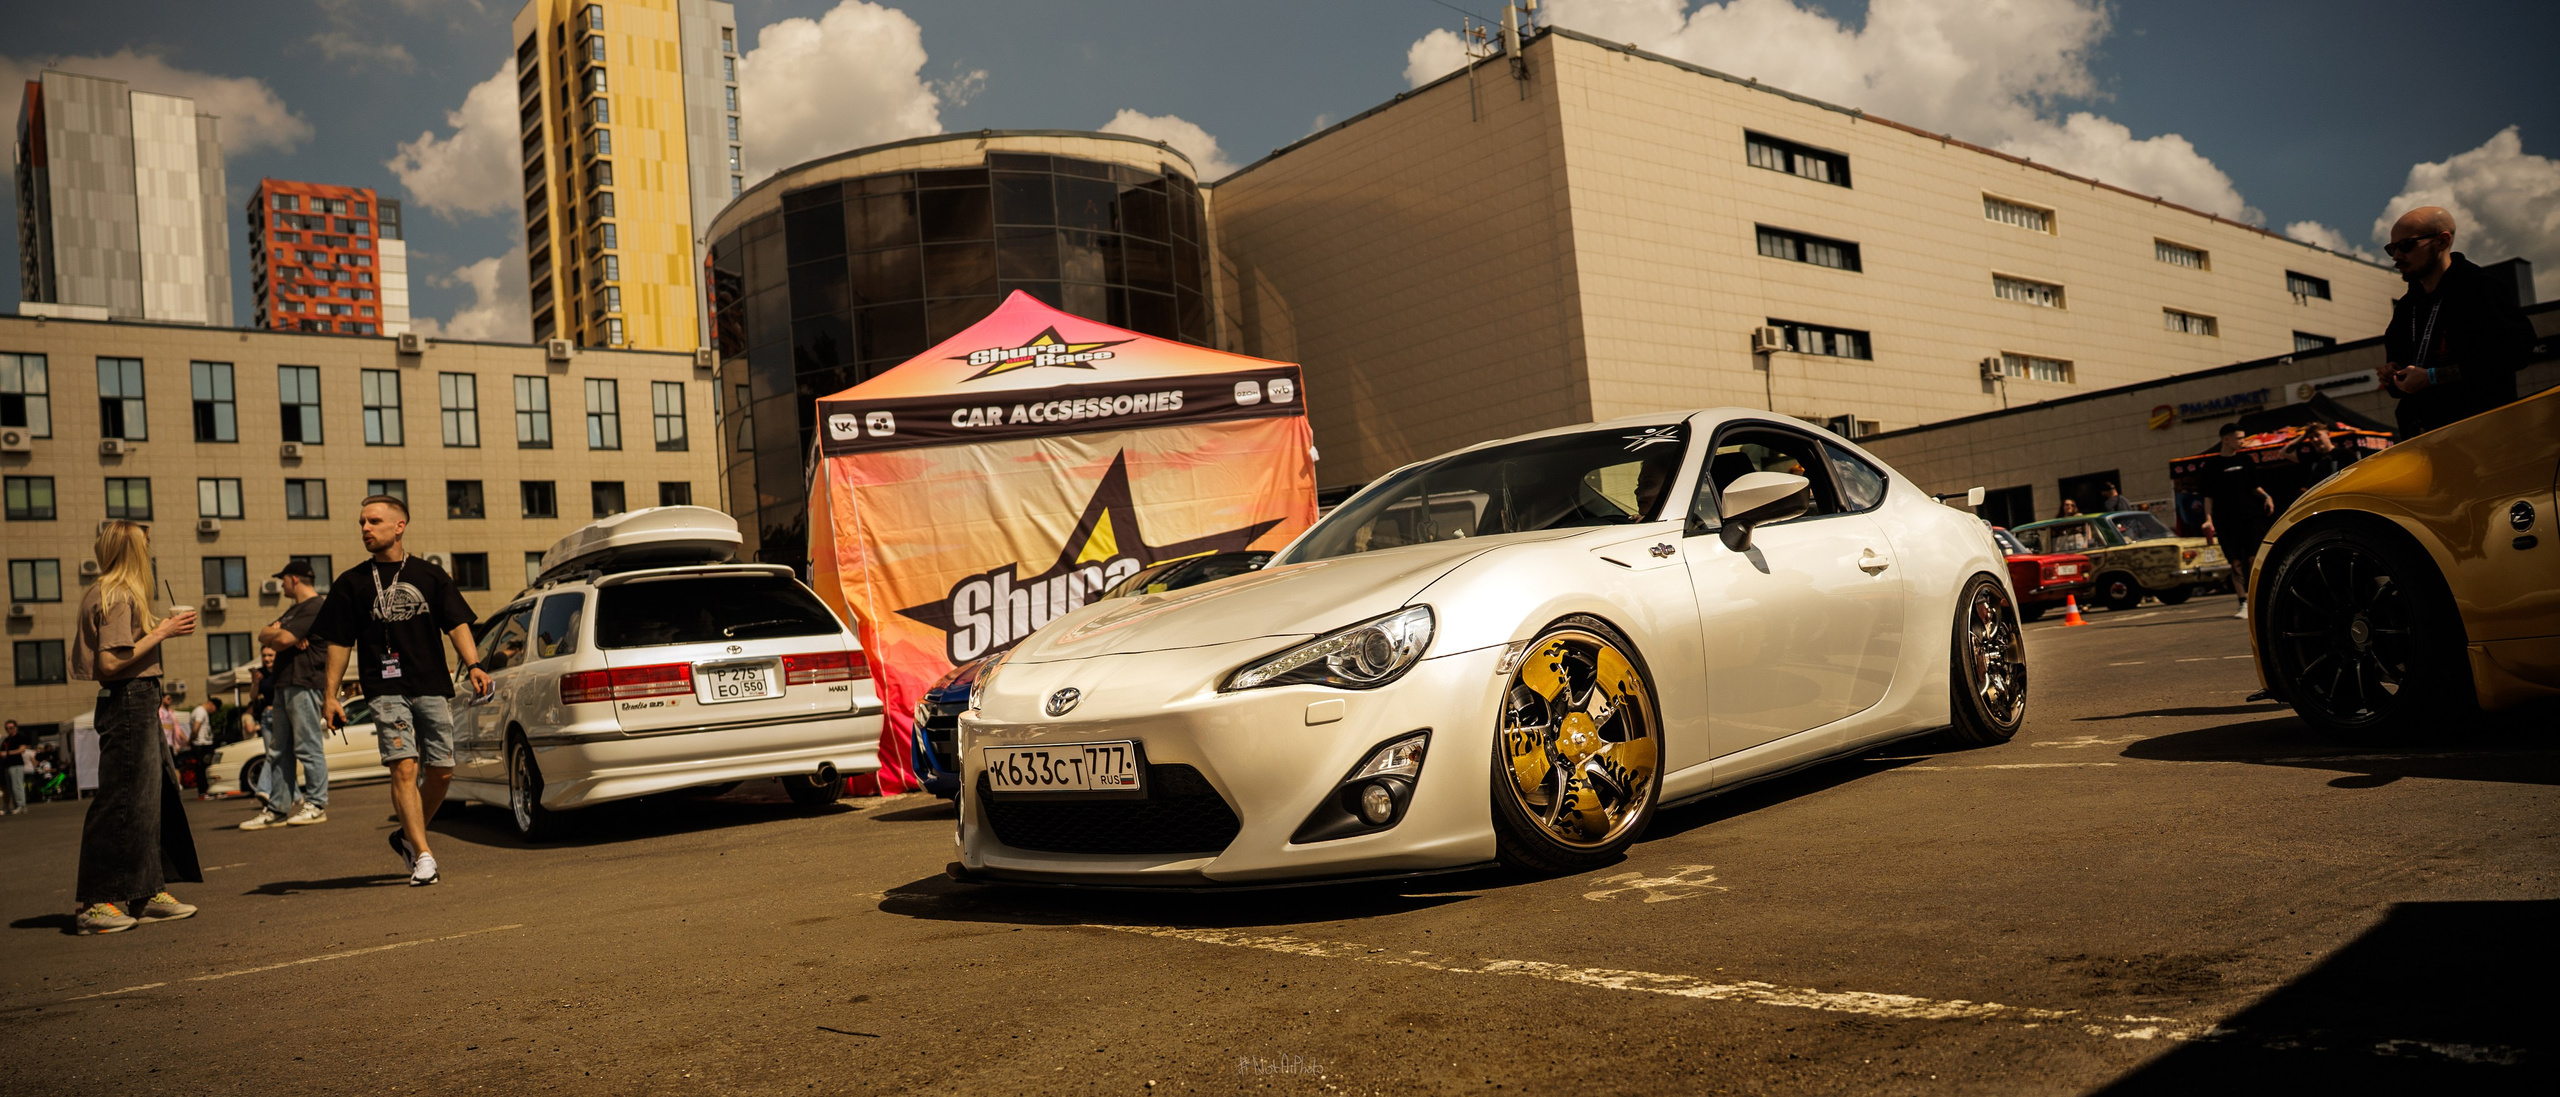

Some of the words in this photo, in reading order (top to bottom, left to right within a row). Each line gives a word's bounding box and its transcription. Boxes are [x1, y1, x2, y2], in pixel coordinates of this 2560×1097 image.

[968, 343, 1067, 366] Shura
[1035, 351, 1114, 367] Race
[951, 407, 1003, 427] CAR
[1008, 390, 1184, 424] ACCSESSORIES
[731, 667, 757, 680] 275
[743, 681, 763, 692] 550
[1085, 747, 1125, 775] 777
[1101, 775, 1120, 785] RUS
